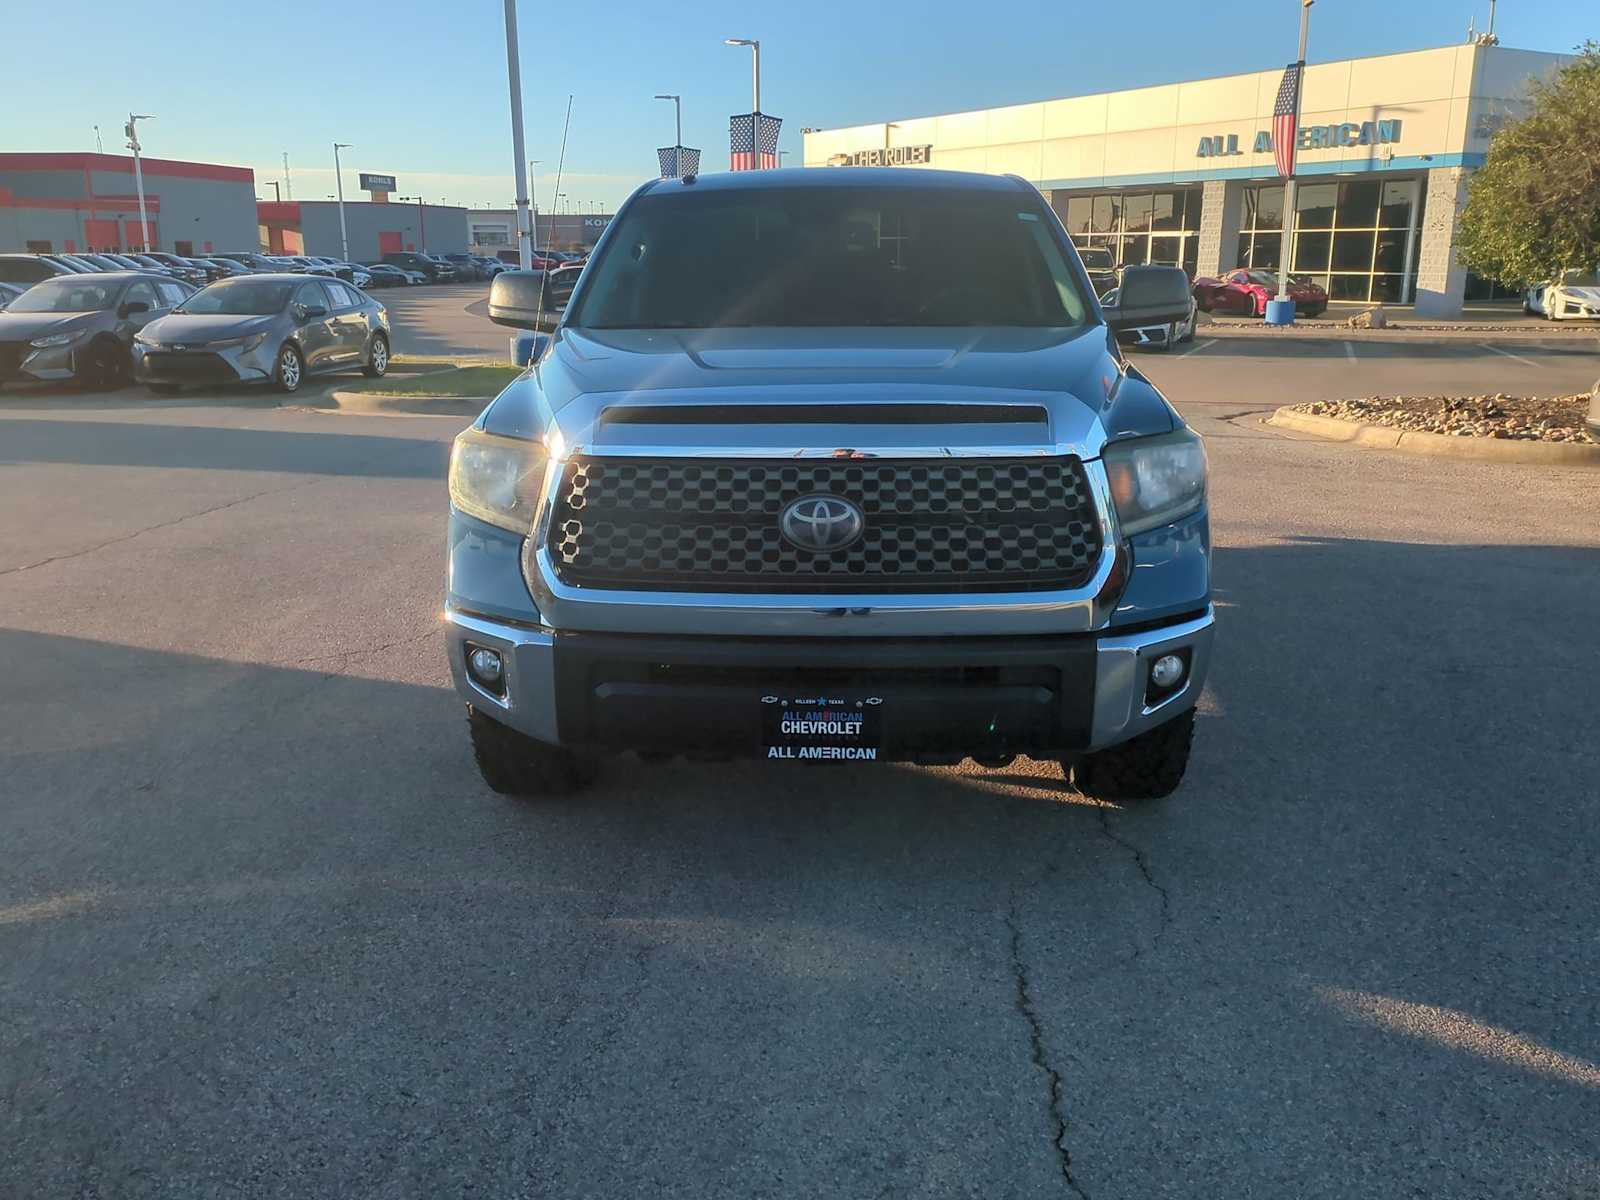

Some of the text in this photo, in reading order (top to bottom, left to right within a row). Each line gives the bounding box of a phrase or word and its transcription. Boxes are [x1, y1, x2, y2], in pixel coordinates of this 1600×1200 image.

[1197, 119, 1402, 157] ALL AERICAN
[849, 144, 933, 167] CHEVROLET
[782, 710, 863, 721] ALL AMERICAN
[781, 721, 862, 734] CHEVROLET
[768, 746, 877, 759] ALL AMERICAN
